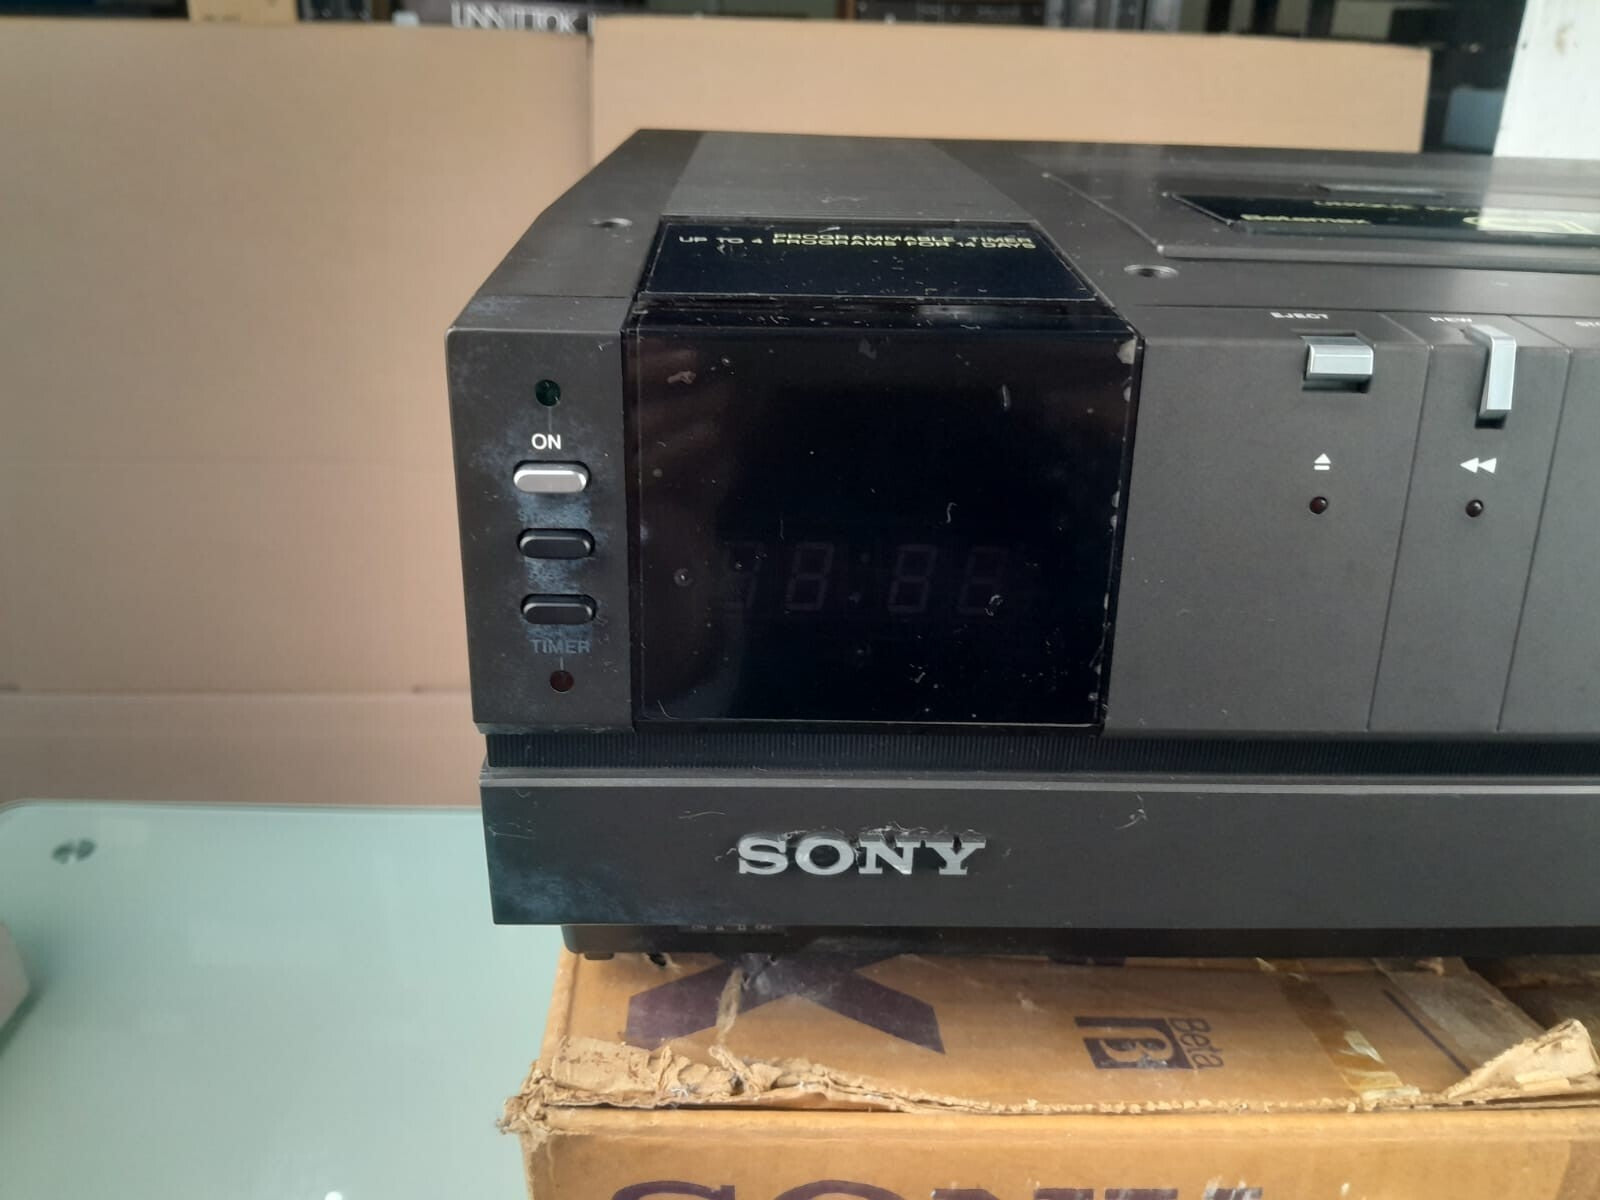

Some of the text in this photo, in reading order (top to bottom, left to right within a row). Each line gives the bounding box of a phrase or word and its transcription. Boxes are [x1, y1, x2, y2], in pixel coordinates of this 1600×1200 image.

[772, 239, 898, 247] PROGRAMS
[773, 232, 955, 243] PROGRAMMABLE
[1269, 311, 1329, 319] EJECT
[531, 433, 562, 450] ON
[529, 638, 592, 654] TIMER
[737, 832, 986, 876] SONY
[1168, 1017, 1225, 1069] Beta
